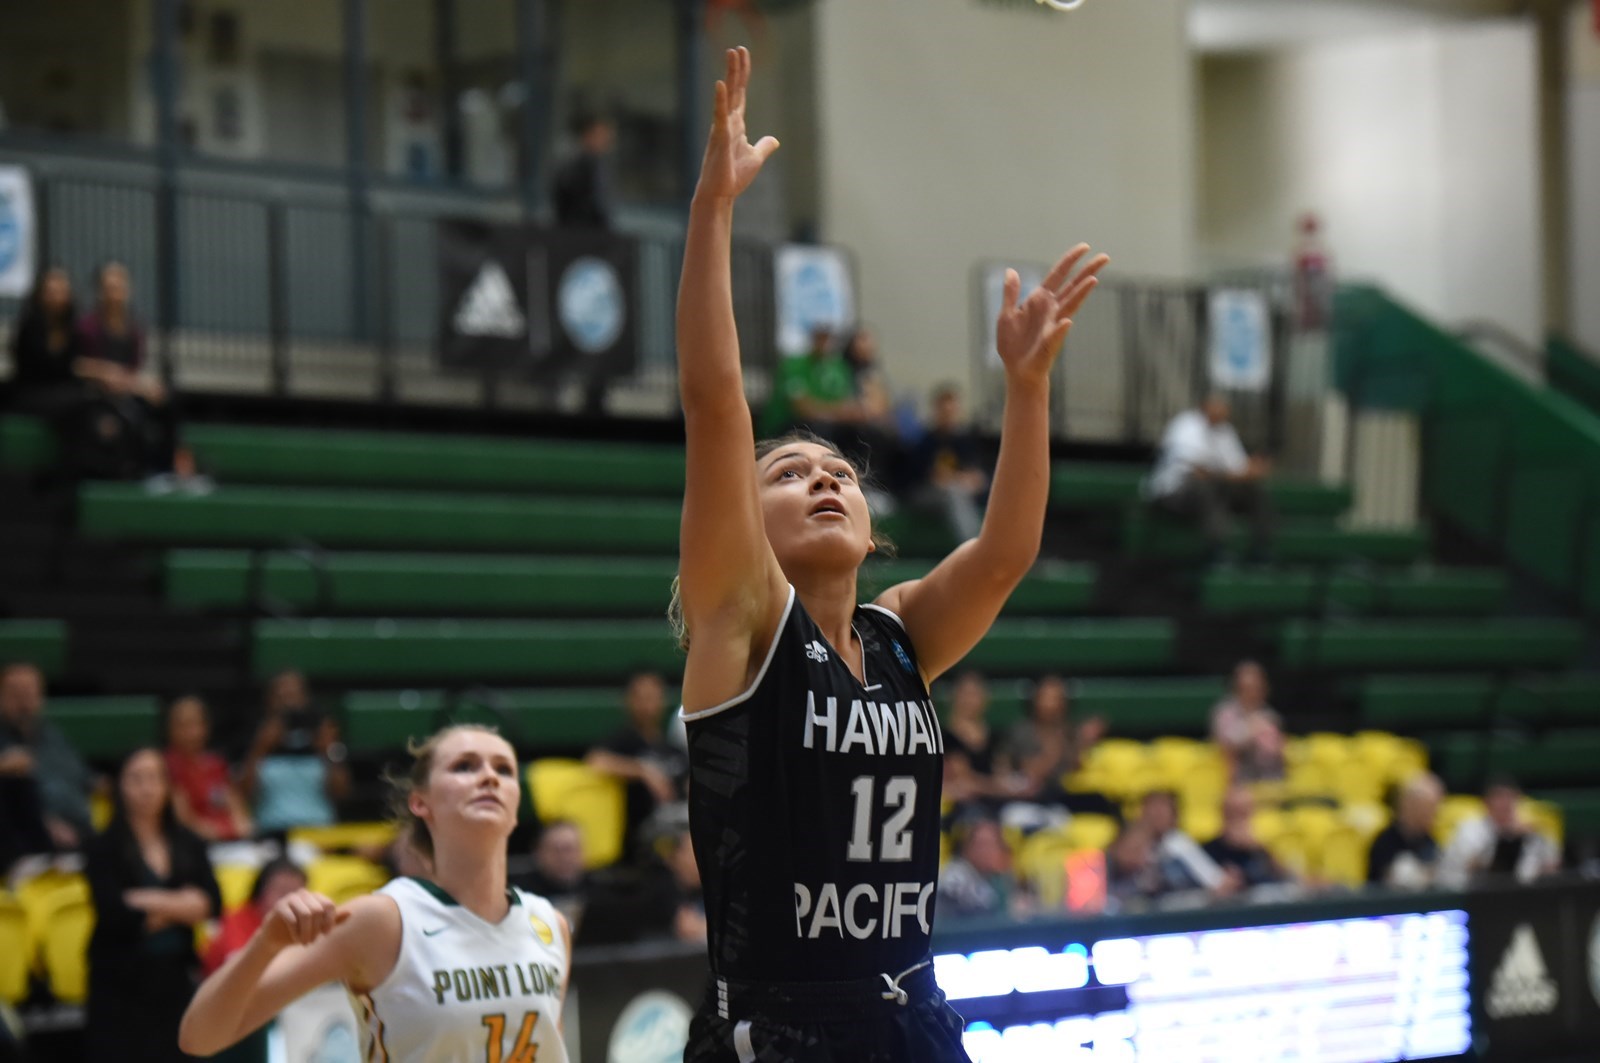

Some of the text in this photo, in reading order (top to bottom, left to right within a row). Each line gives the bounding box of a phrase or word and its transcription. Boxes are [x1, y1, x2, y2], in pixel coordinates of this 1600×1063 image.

[846, 775, 918, 862] 12
[432, 965, 511, 1005] POINT
[481, 1011, 540, 1063] 14
